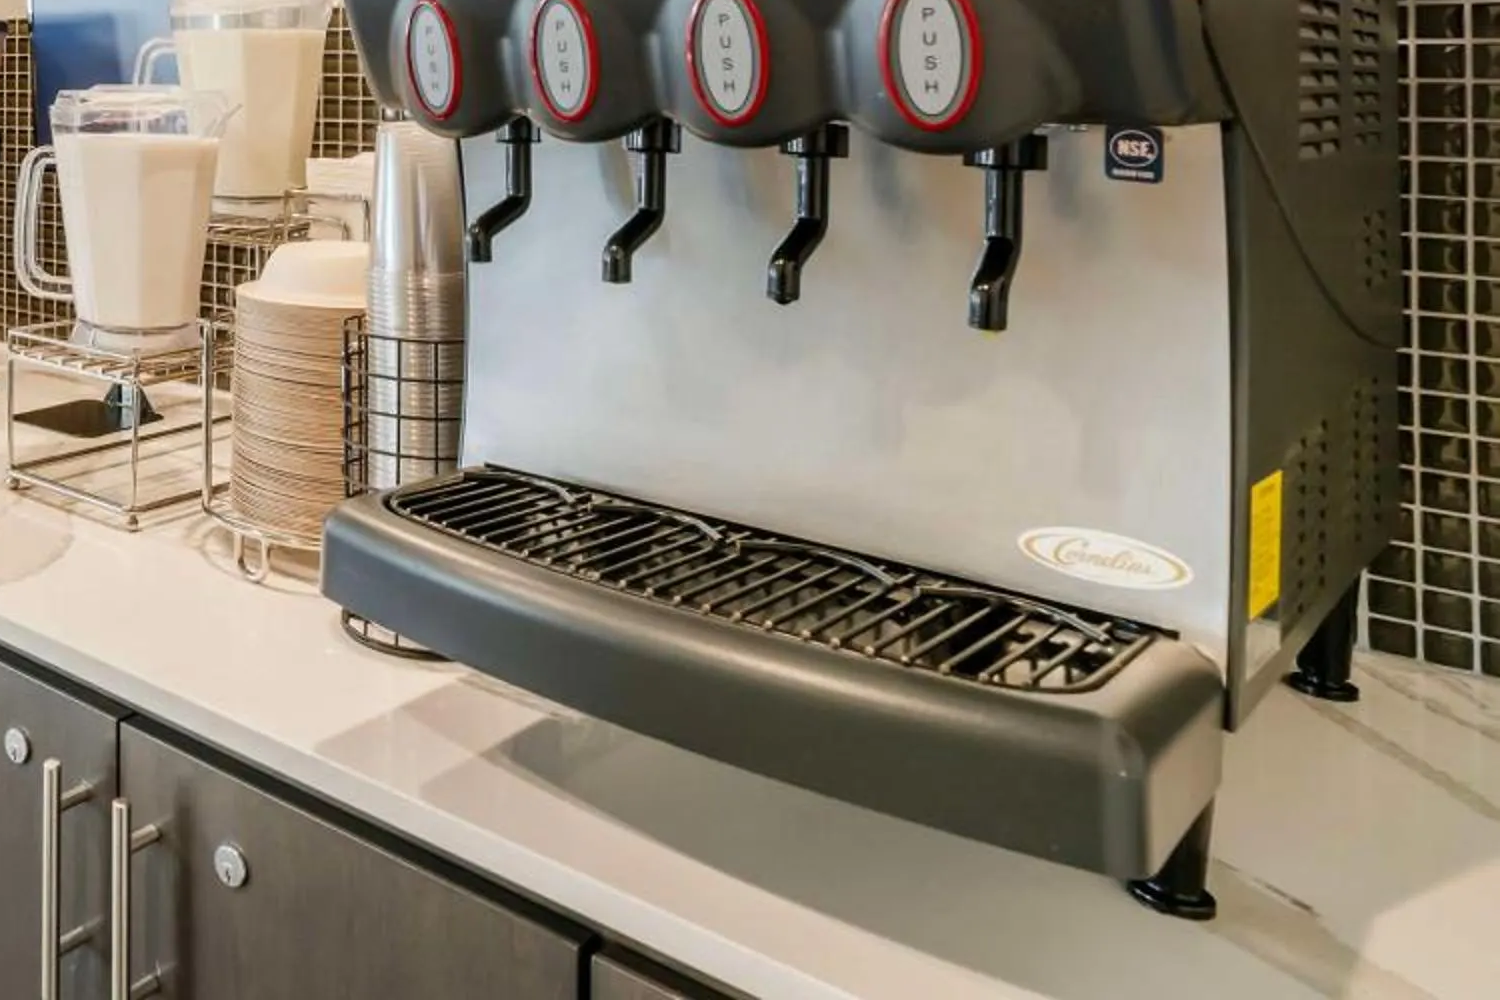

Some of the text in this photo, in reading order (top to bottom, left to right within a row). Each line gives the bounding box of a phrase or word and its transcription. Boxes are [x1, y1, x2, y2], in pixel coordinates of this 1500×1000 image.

[424, 25, 439, 90] PUSH
[555, 20, 571, 93] PUSH
[718, 13, 736, 93] PUSH
[921, 7, 939, 93] PUSH
